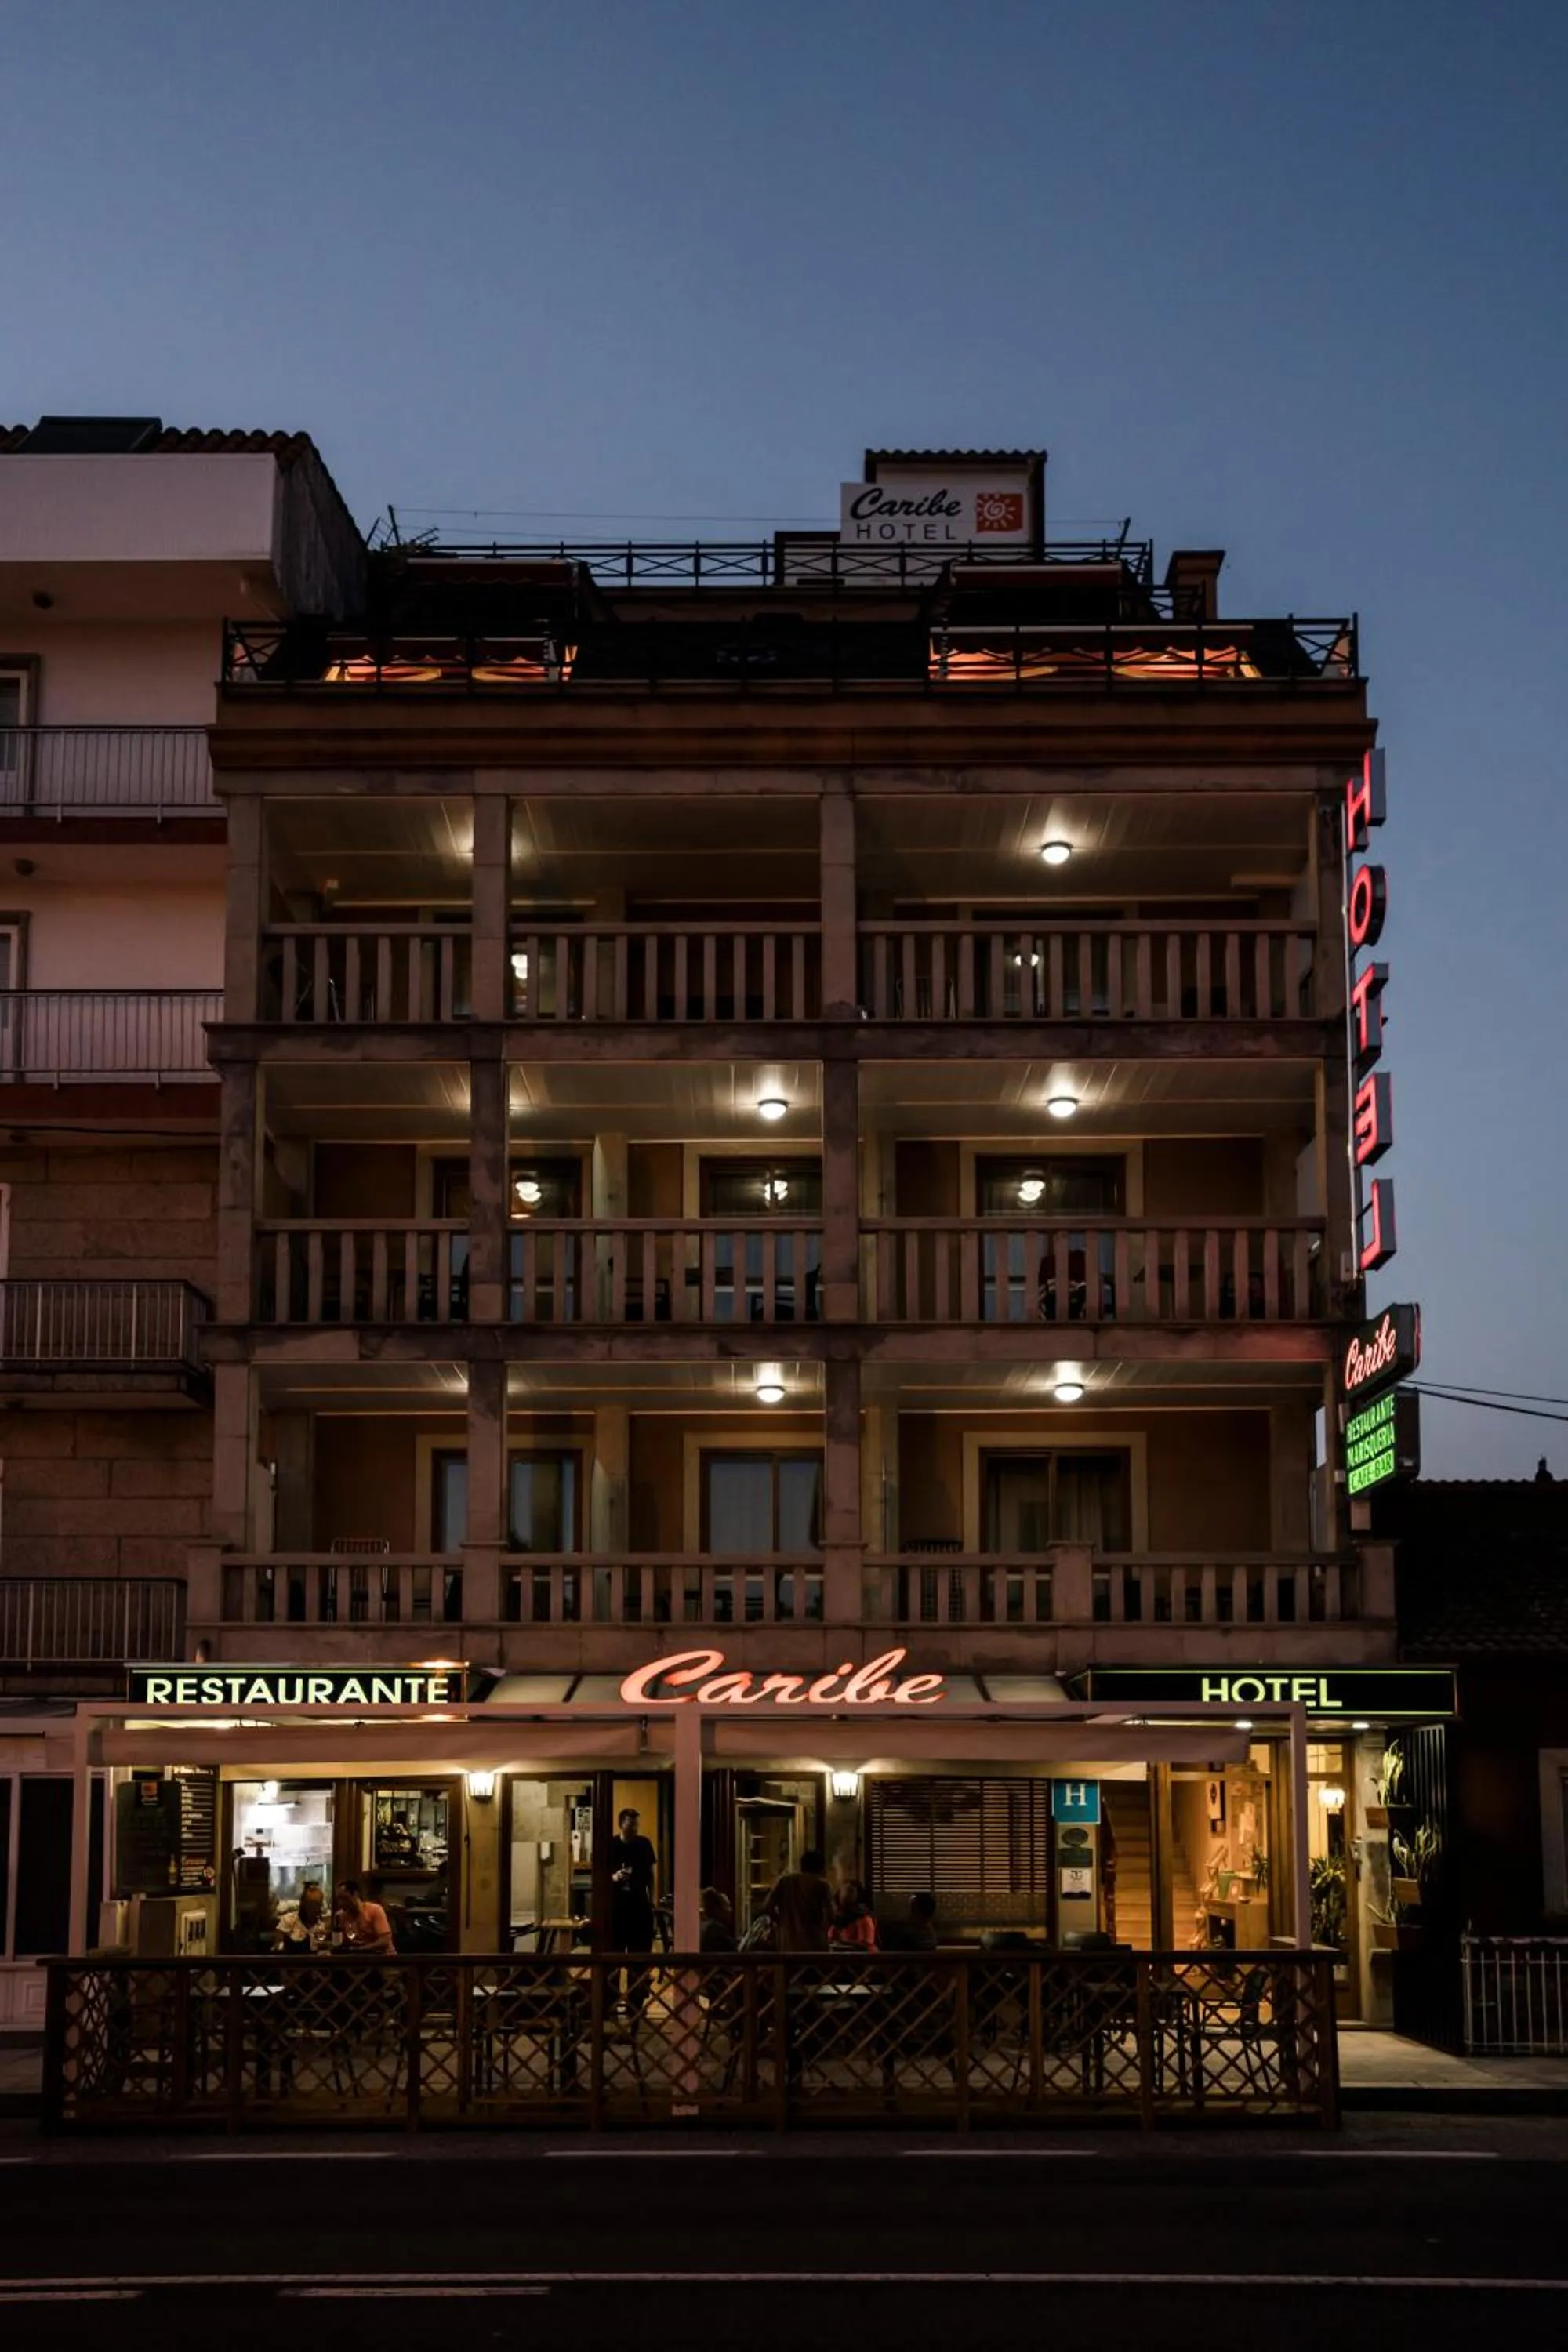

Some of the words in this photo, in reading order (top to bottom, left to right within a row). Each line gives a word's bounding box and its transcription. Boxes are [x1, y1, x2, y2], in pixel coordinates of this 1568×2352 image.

[850, 488, 961, 520] Caribe
[857, 523, 956, 540] HOTEL
[1345, 1312, 1396, 1390] Caribe
[1346, 1393, 1395, 1443] RESTAURANTE
[146, 1678, 449, 1704] RESTAURANTE
[620, 1648, 947, 1704] Caribe
[1201, 1677, 1342, 1707] HOTEL
[1063, 1783, 1087, 1806] H
